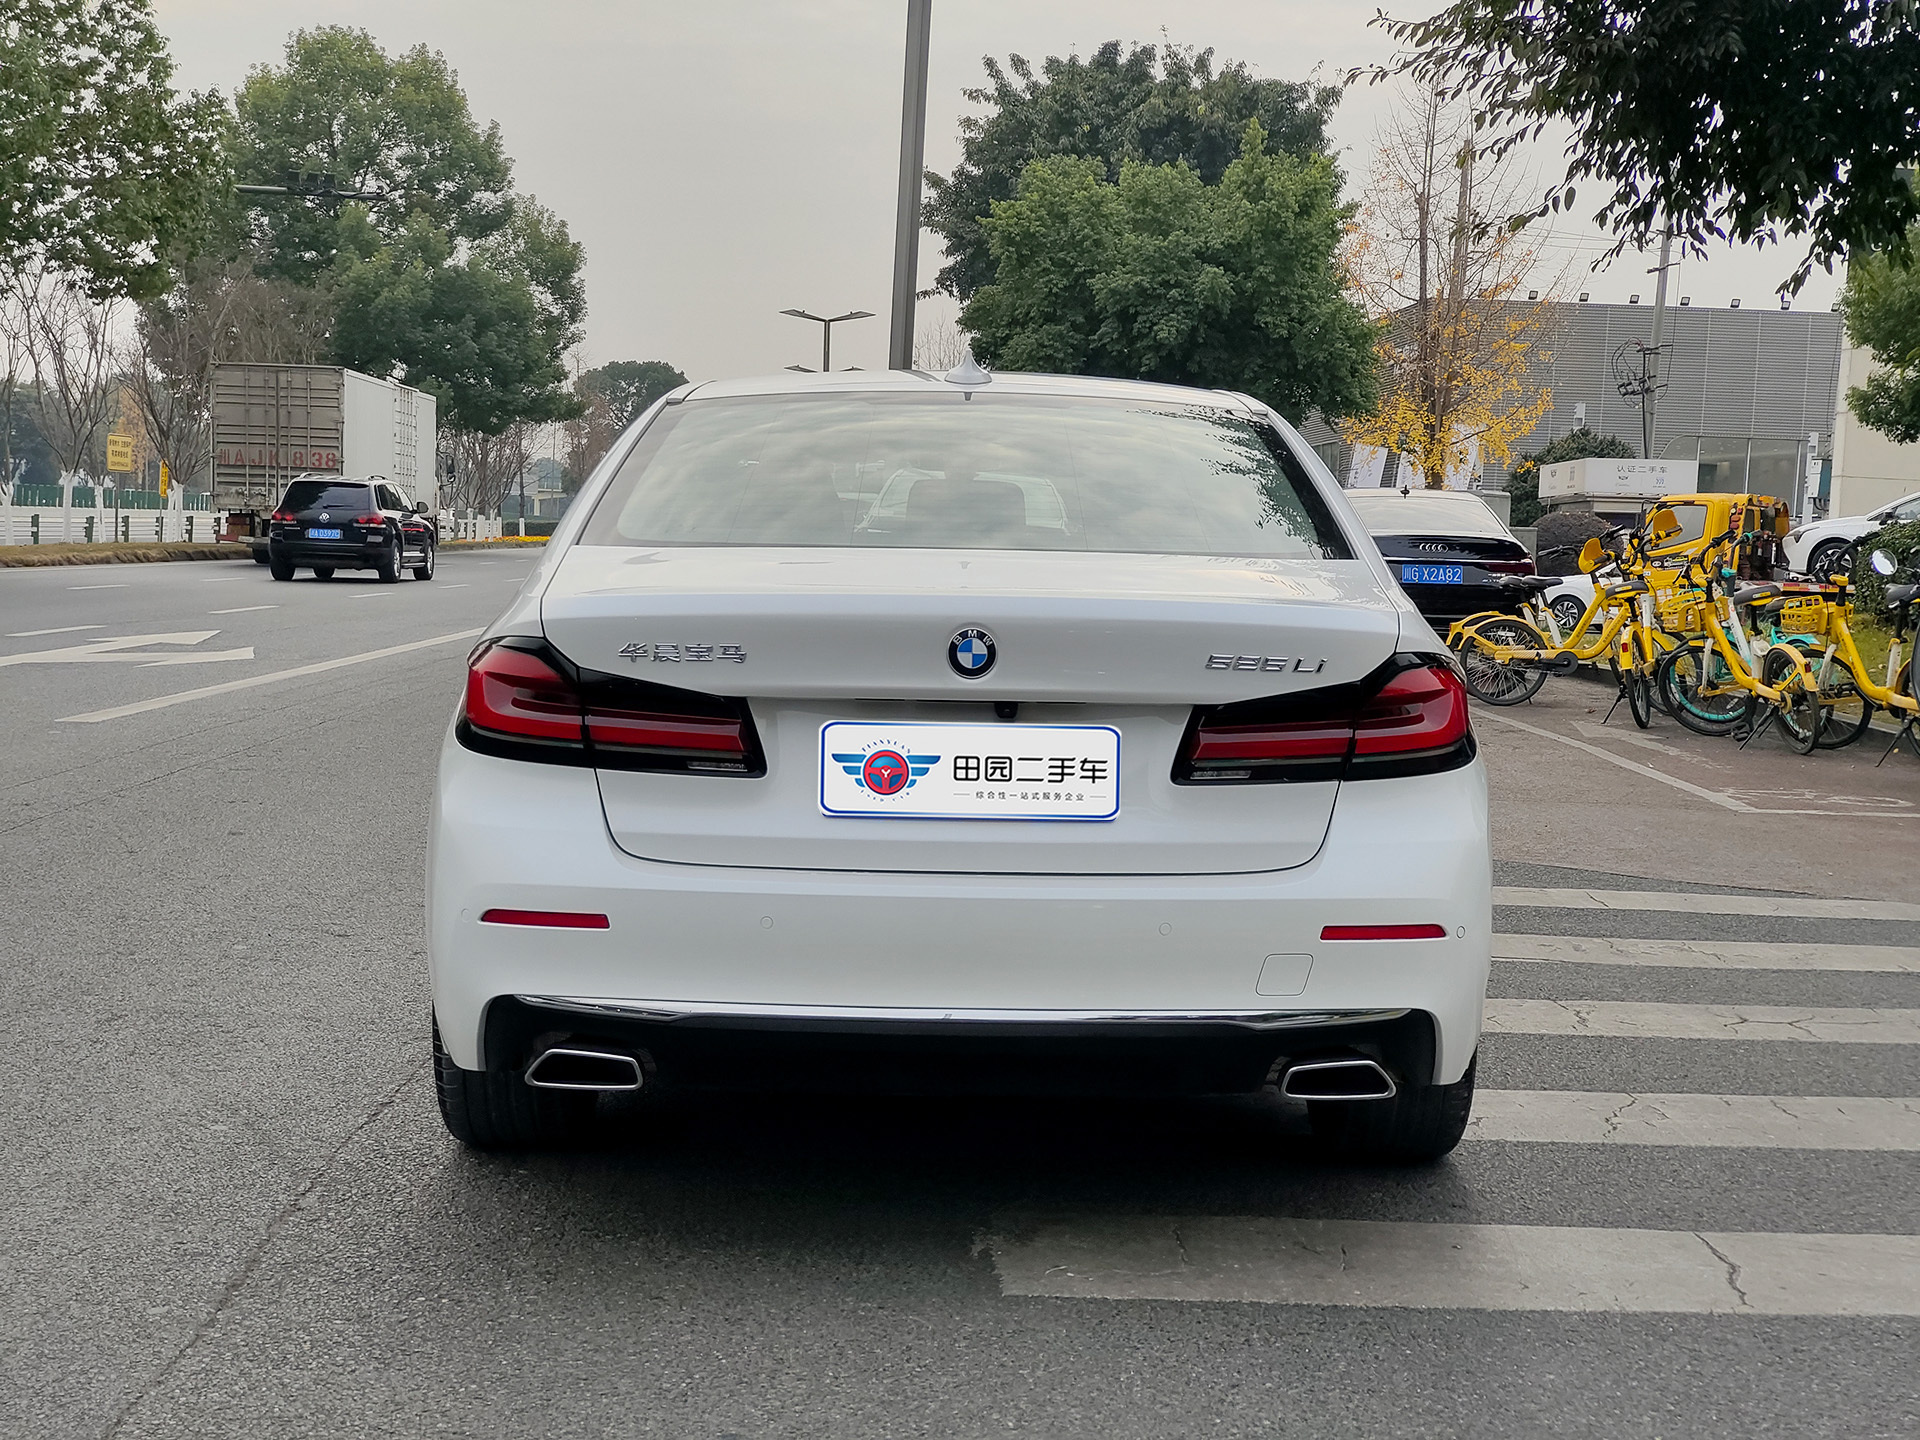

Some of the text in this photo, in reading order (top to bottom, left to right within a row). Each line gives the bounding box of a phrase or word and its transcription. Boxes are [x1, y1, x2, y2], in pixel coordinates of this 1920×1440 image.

[1617, 465, 1668, 474] 认证二手车
[952, 629, 993, 647] BMW
[618, 641, 747, 663] 华晨宝马
[953, 756, 1108, 784] 田园二手车
[975, 790, 1085, 802] 综合性一站式服务企业
